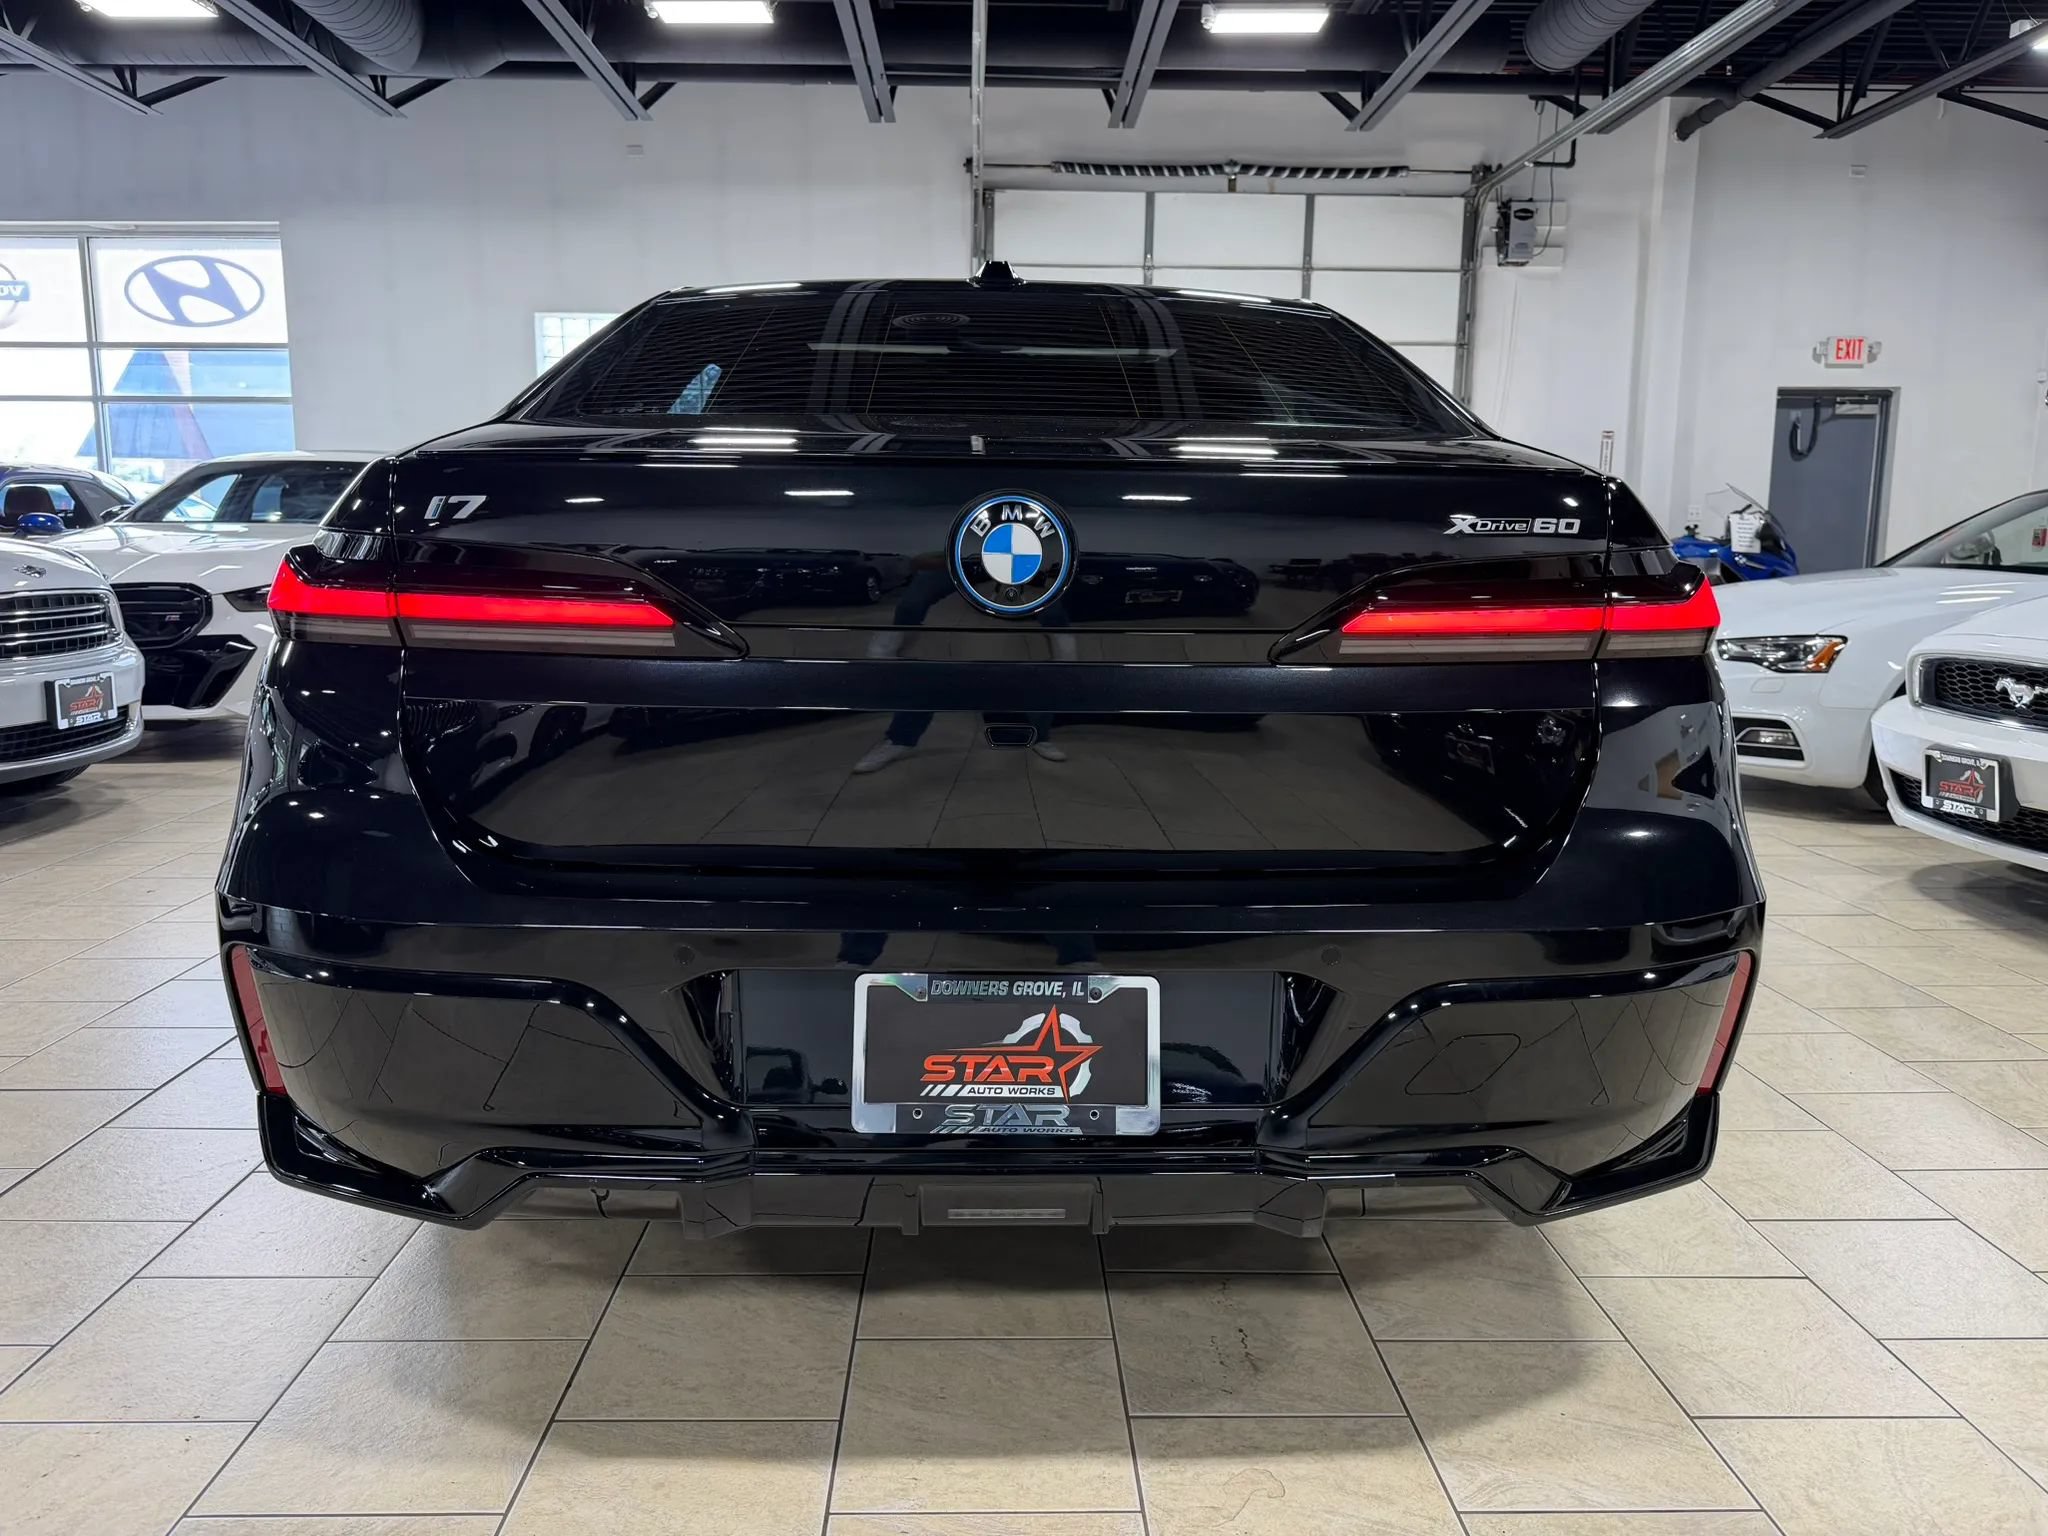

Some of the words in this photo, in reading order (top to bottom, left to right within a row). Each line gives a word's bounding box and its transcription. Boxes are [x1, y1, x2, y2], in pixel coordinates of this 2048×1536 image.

[1836, 338, 1864, 360] EXIT
[424, 495, 487, 519] i7
[970, 504, 1056, 539] BMW
[1533, 518, 1581, 534] 60
[1942, 799, 1976, 815] STAR
[930, 979, 1009, 996] DOWNERS
[1012, 980, 1067, 998] GROVE,
[1071, 981, 1085, 996] IL
[920, 1054, 1054, 1082] STAR
[967, 1086, 1003, 1096] AUTO
[1008, 1086, 1056, 1096] WORKS
[941, 1103, 1071, 1126] STAR
